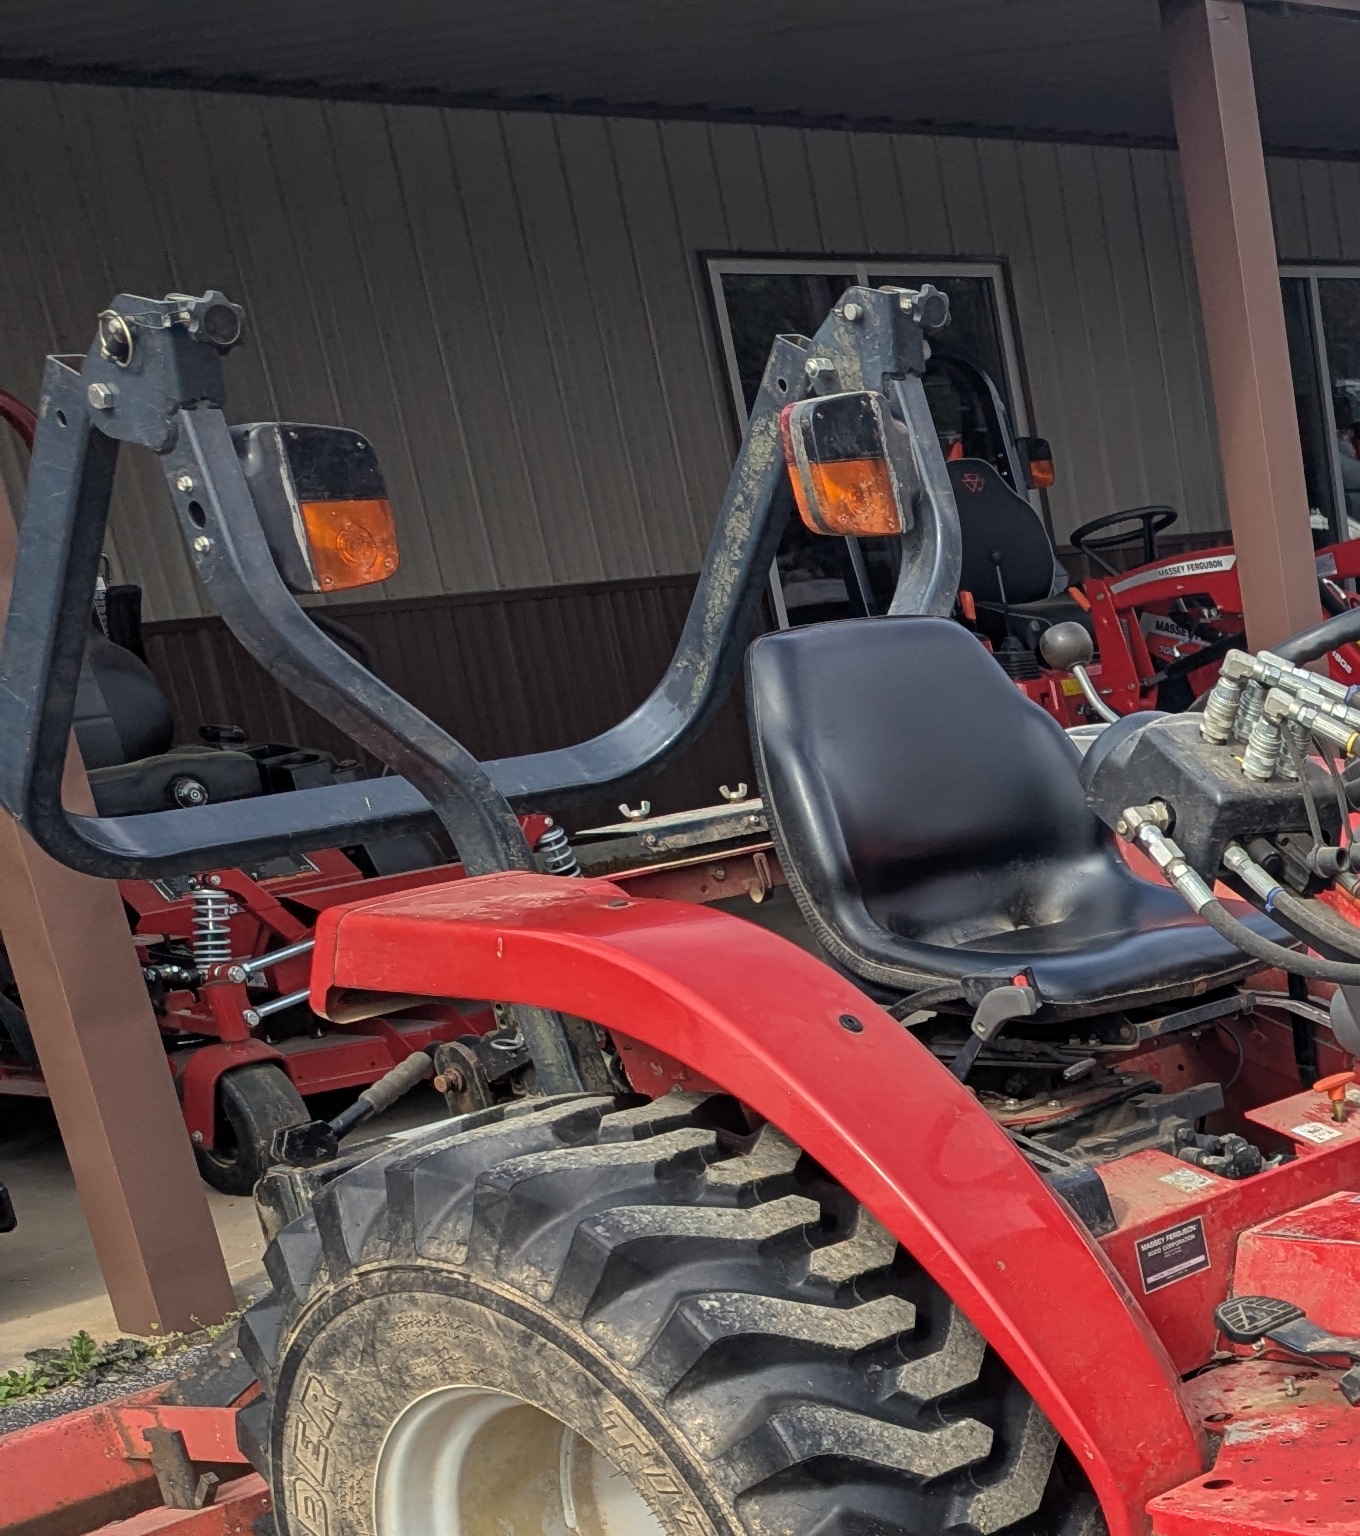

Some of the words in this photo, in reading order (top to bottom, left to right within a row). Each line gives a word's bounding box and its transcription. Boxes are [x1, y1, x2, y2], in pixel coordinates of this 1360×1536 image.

[1158, 565, 1186, 578] MASSEY
[1187, 559, 1224, 573] FERGUSON
[1140, 1236, 1165, 1252] MASSEY
[1166, 1225, 1197, 1242] FERGUSON
